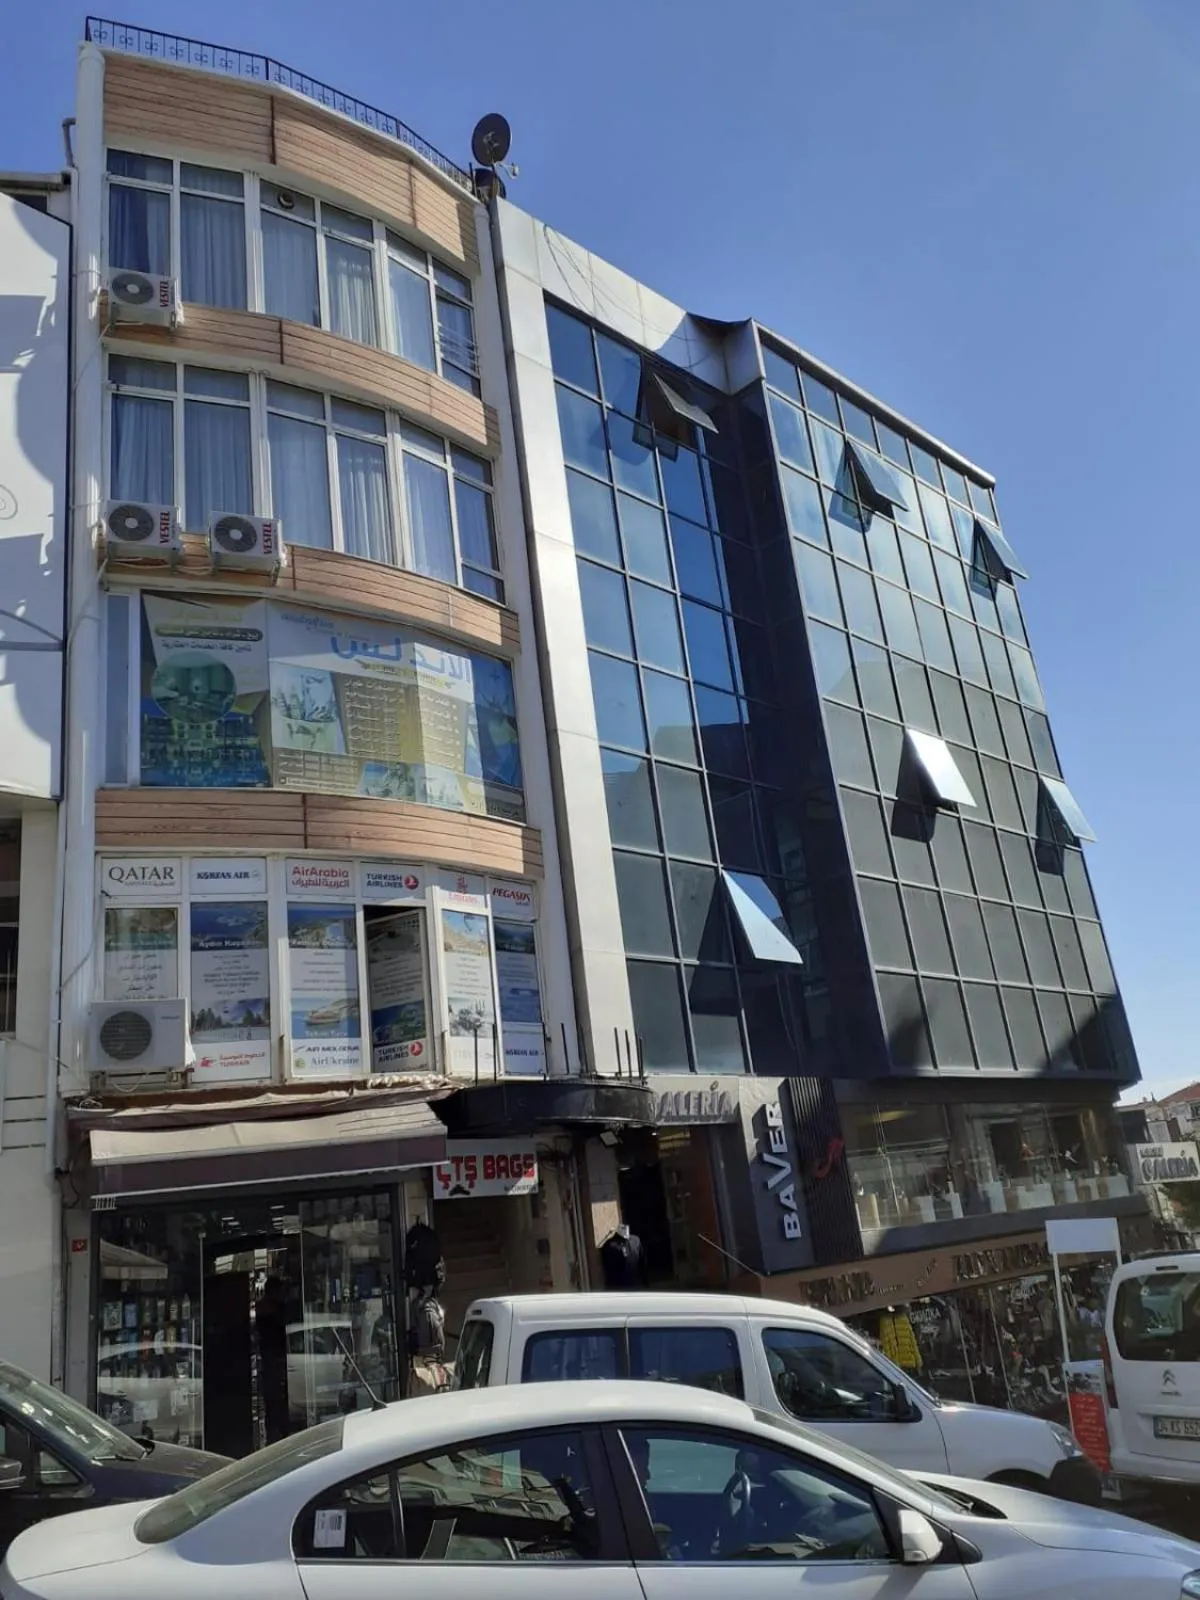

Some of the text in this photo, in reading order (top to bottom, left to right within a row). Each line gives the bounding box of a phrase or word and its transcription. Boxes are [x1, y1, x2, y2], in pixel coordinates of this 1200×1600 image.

[160, 279, 169, 308] VESTEL
[159, 510, 170, 545] VESTEL
[263, 522, 273, 555] VESTEL
[109, 866, 180, 883] QATAR
[367, 873, 403, 881] TURKISH
[367, 881, 403, 889] AIRLINES
[493, 887, 531, 902] PEGASUS
[378, 1051, 409, 1064] AIRLINES
[483, 1154, 535, 1181] BAGS
[763, 1101, 802, 1240] BAVER
